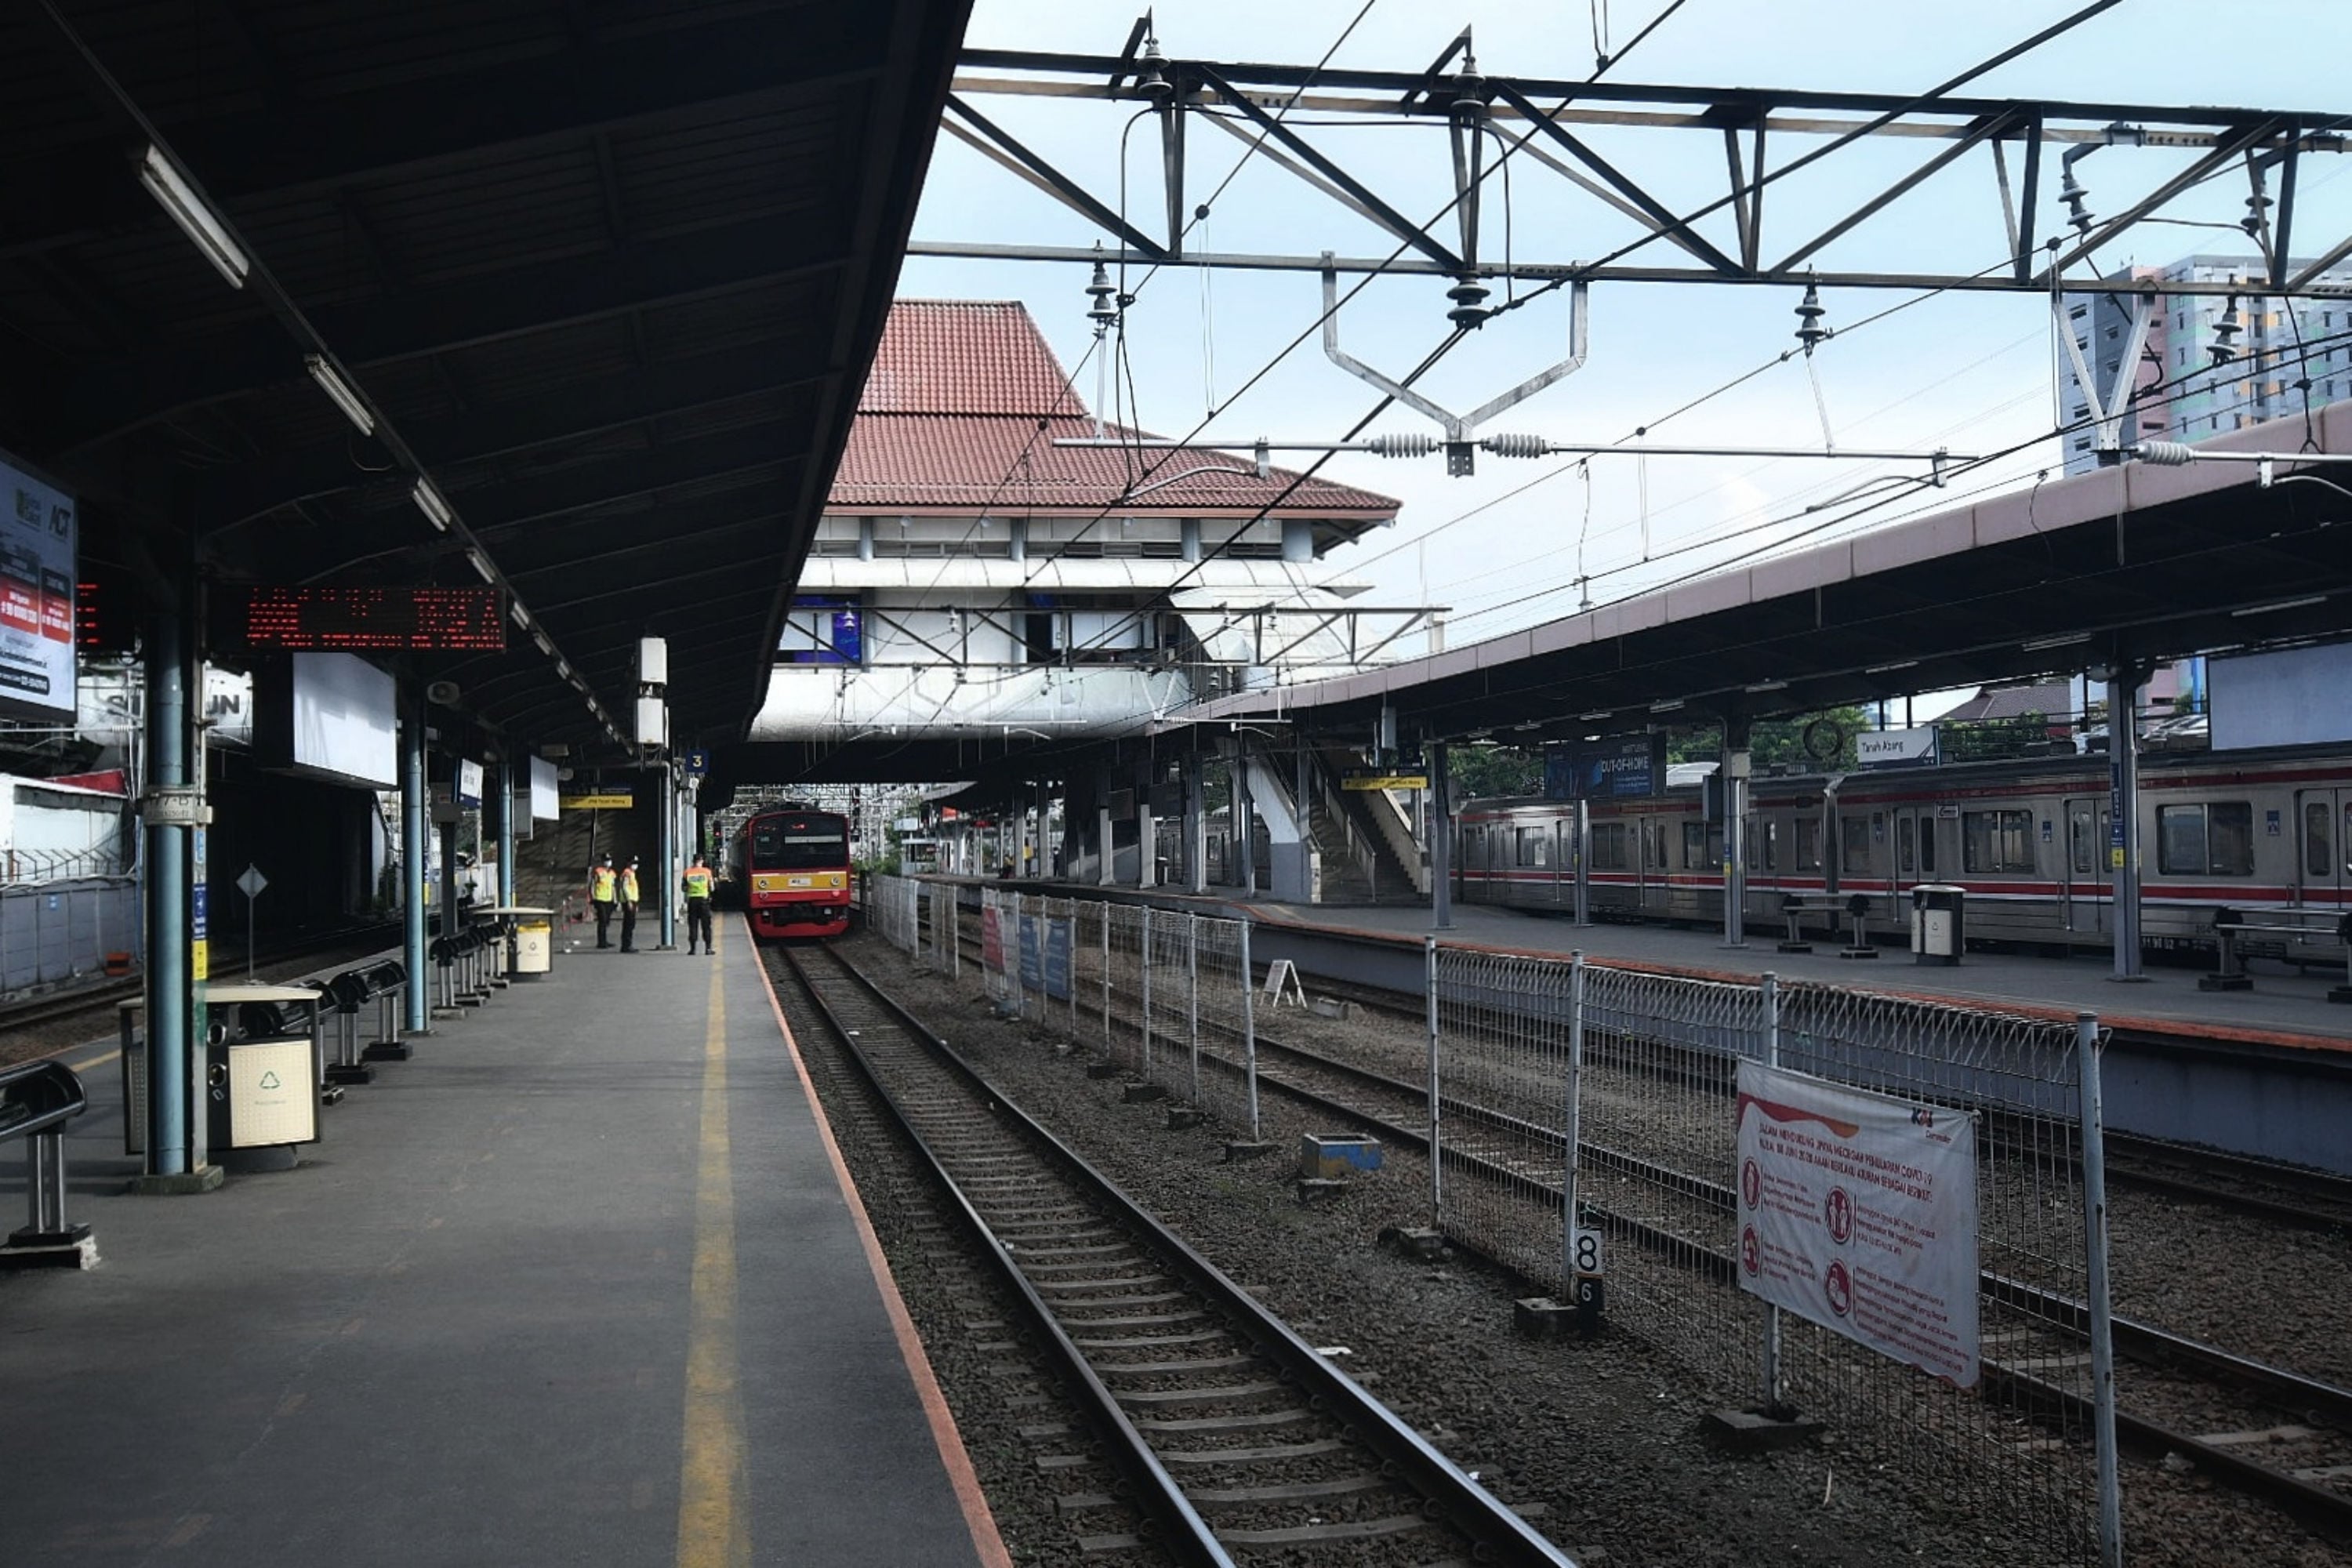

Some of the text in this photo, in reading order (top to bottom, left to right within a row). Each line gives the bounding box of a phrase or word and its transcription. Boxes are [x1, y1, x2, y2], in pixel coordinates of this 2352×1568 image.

[49, 505, 71, 539] ACT
[1861, 739, 1882, 753] Tanah
[692, 755, 702, 768] 3
[1602, 756, 1650, 772] OUT-OF-HOME
[1577, 1235, 1597, 1272] 8
[1581, 1283, 1592, 1301] 6
